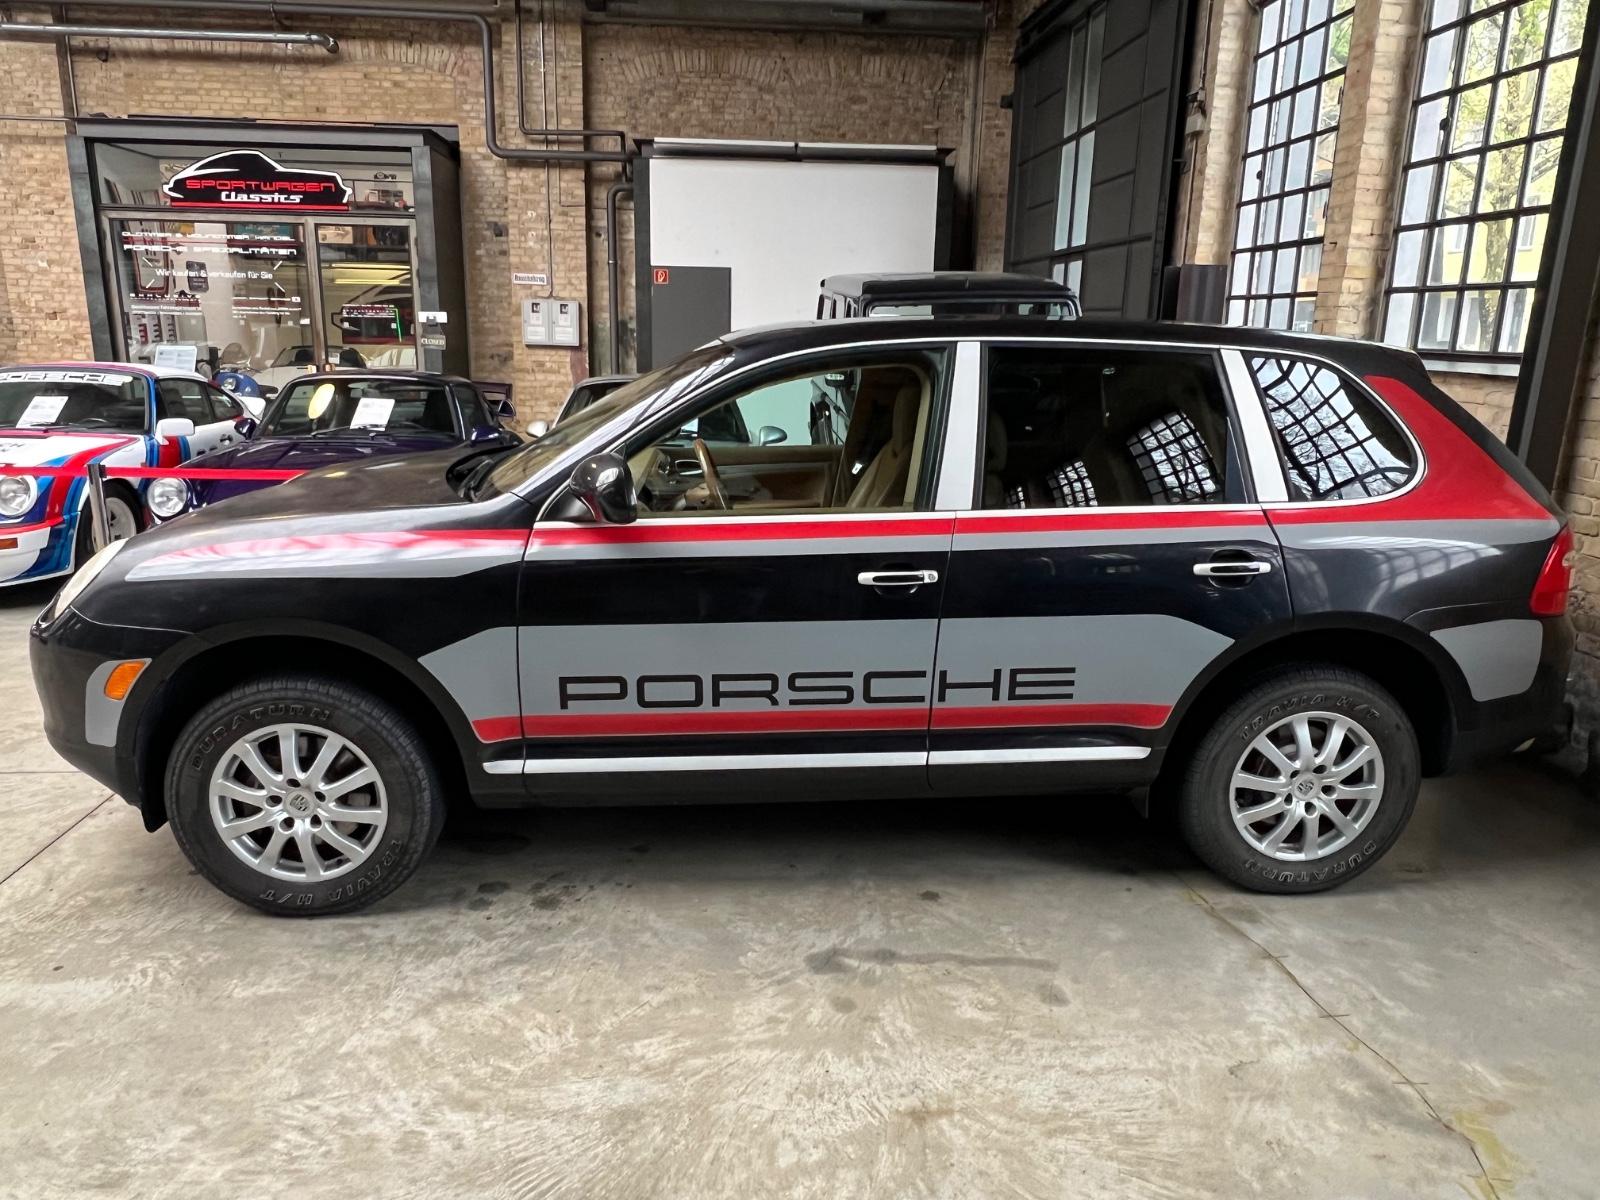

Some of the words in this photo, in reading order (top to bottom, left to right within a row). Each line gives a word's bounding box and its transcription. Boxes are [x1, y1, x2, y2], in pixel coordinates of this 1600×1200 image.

[186, 180, 335, 193] SPORTWAGEN
[221, 191, 304, 204] Classics
[123, 244, 188, 252] PORSCHE
[155, 268, 170, 277] Wir
[247, 270, 260, 279] für
[260, 271, 273, 280] Sie
[558, 667, 1076, 710] PORSCHE
